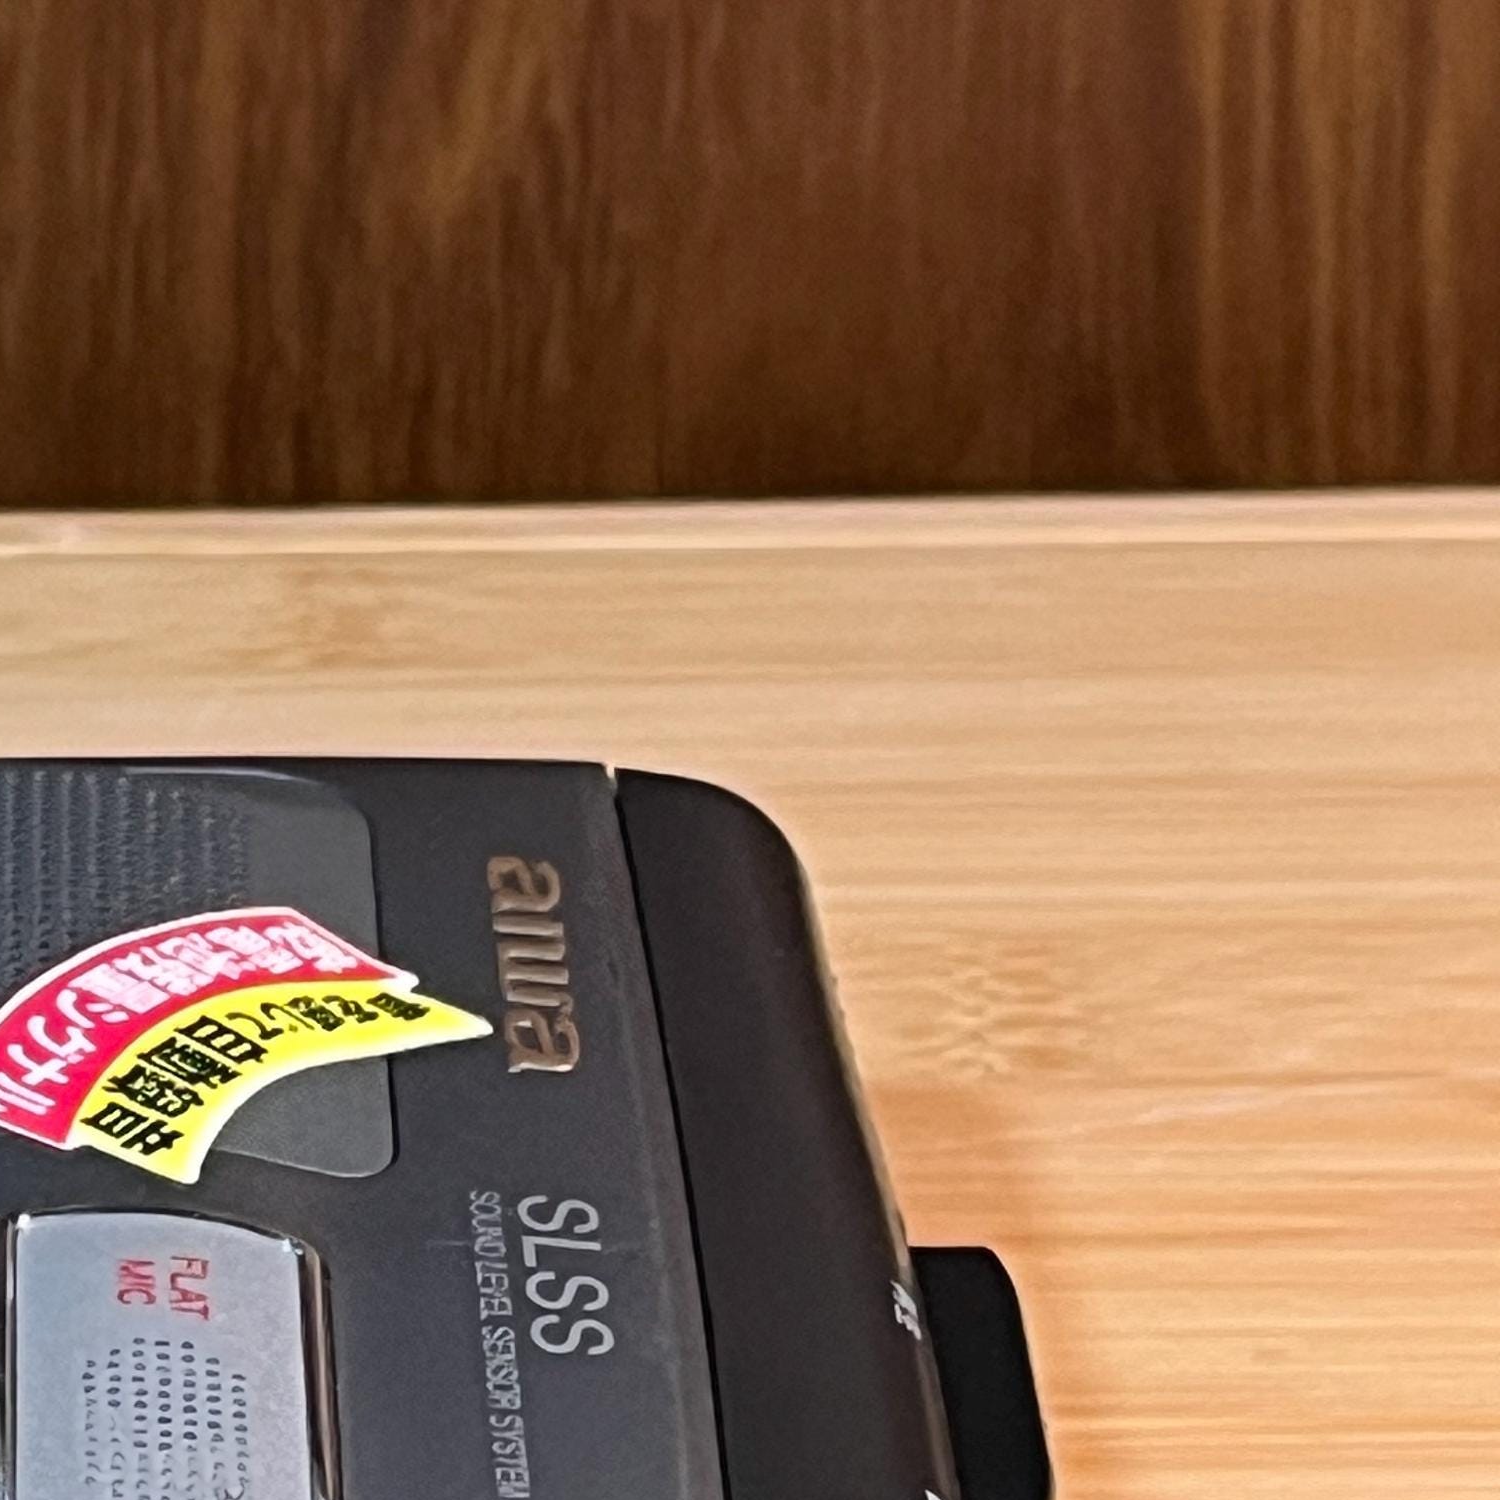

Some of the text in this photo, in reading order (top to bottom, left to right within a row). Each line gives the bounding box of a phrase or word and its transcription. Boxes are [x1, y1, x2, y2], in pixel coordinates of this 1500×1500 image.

[487, 857, 580, 1074] aiwa
[117, 1259, 156, 1304] MIC
[169, 1255, 209, 1320] FLAT
[470, 1189, 507, 1258] SOUND
[489, 1415, 530, 1498] SYSTEM
[517, 1195, 615, 1355] SLSS
